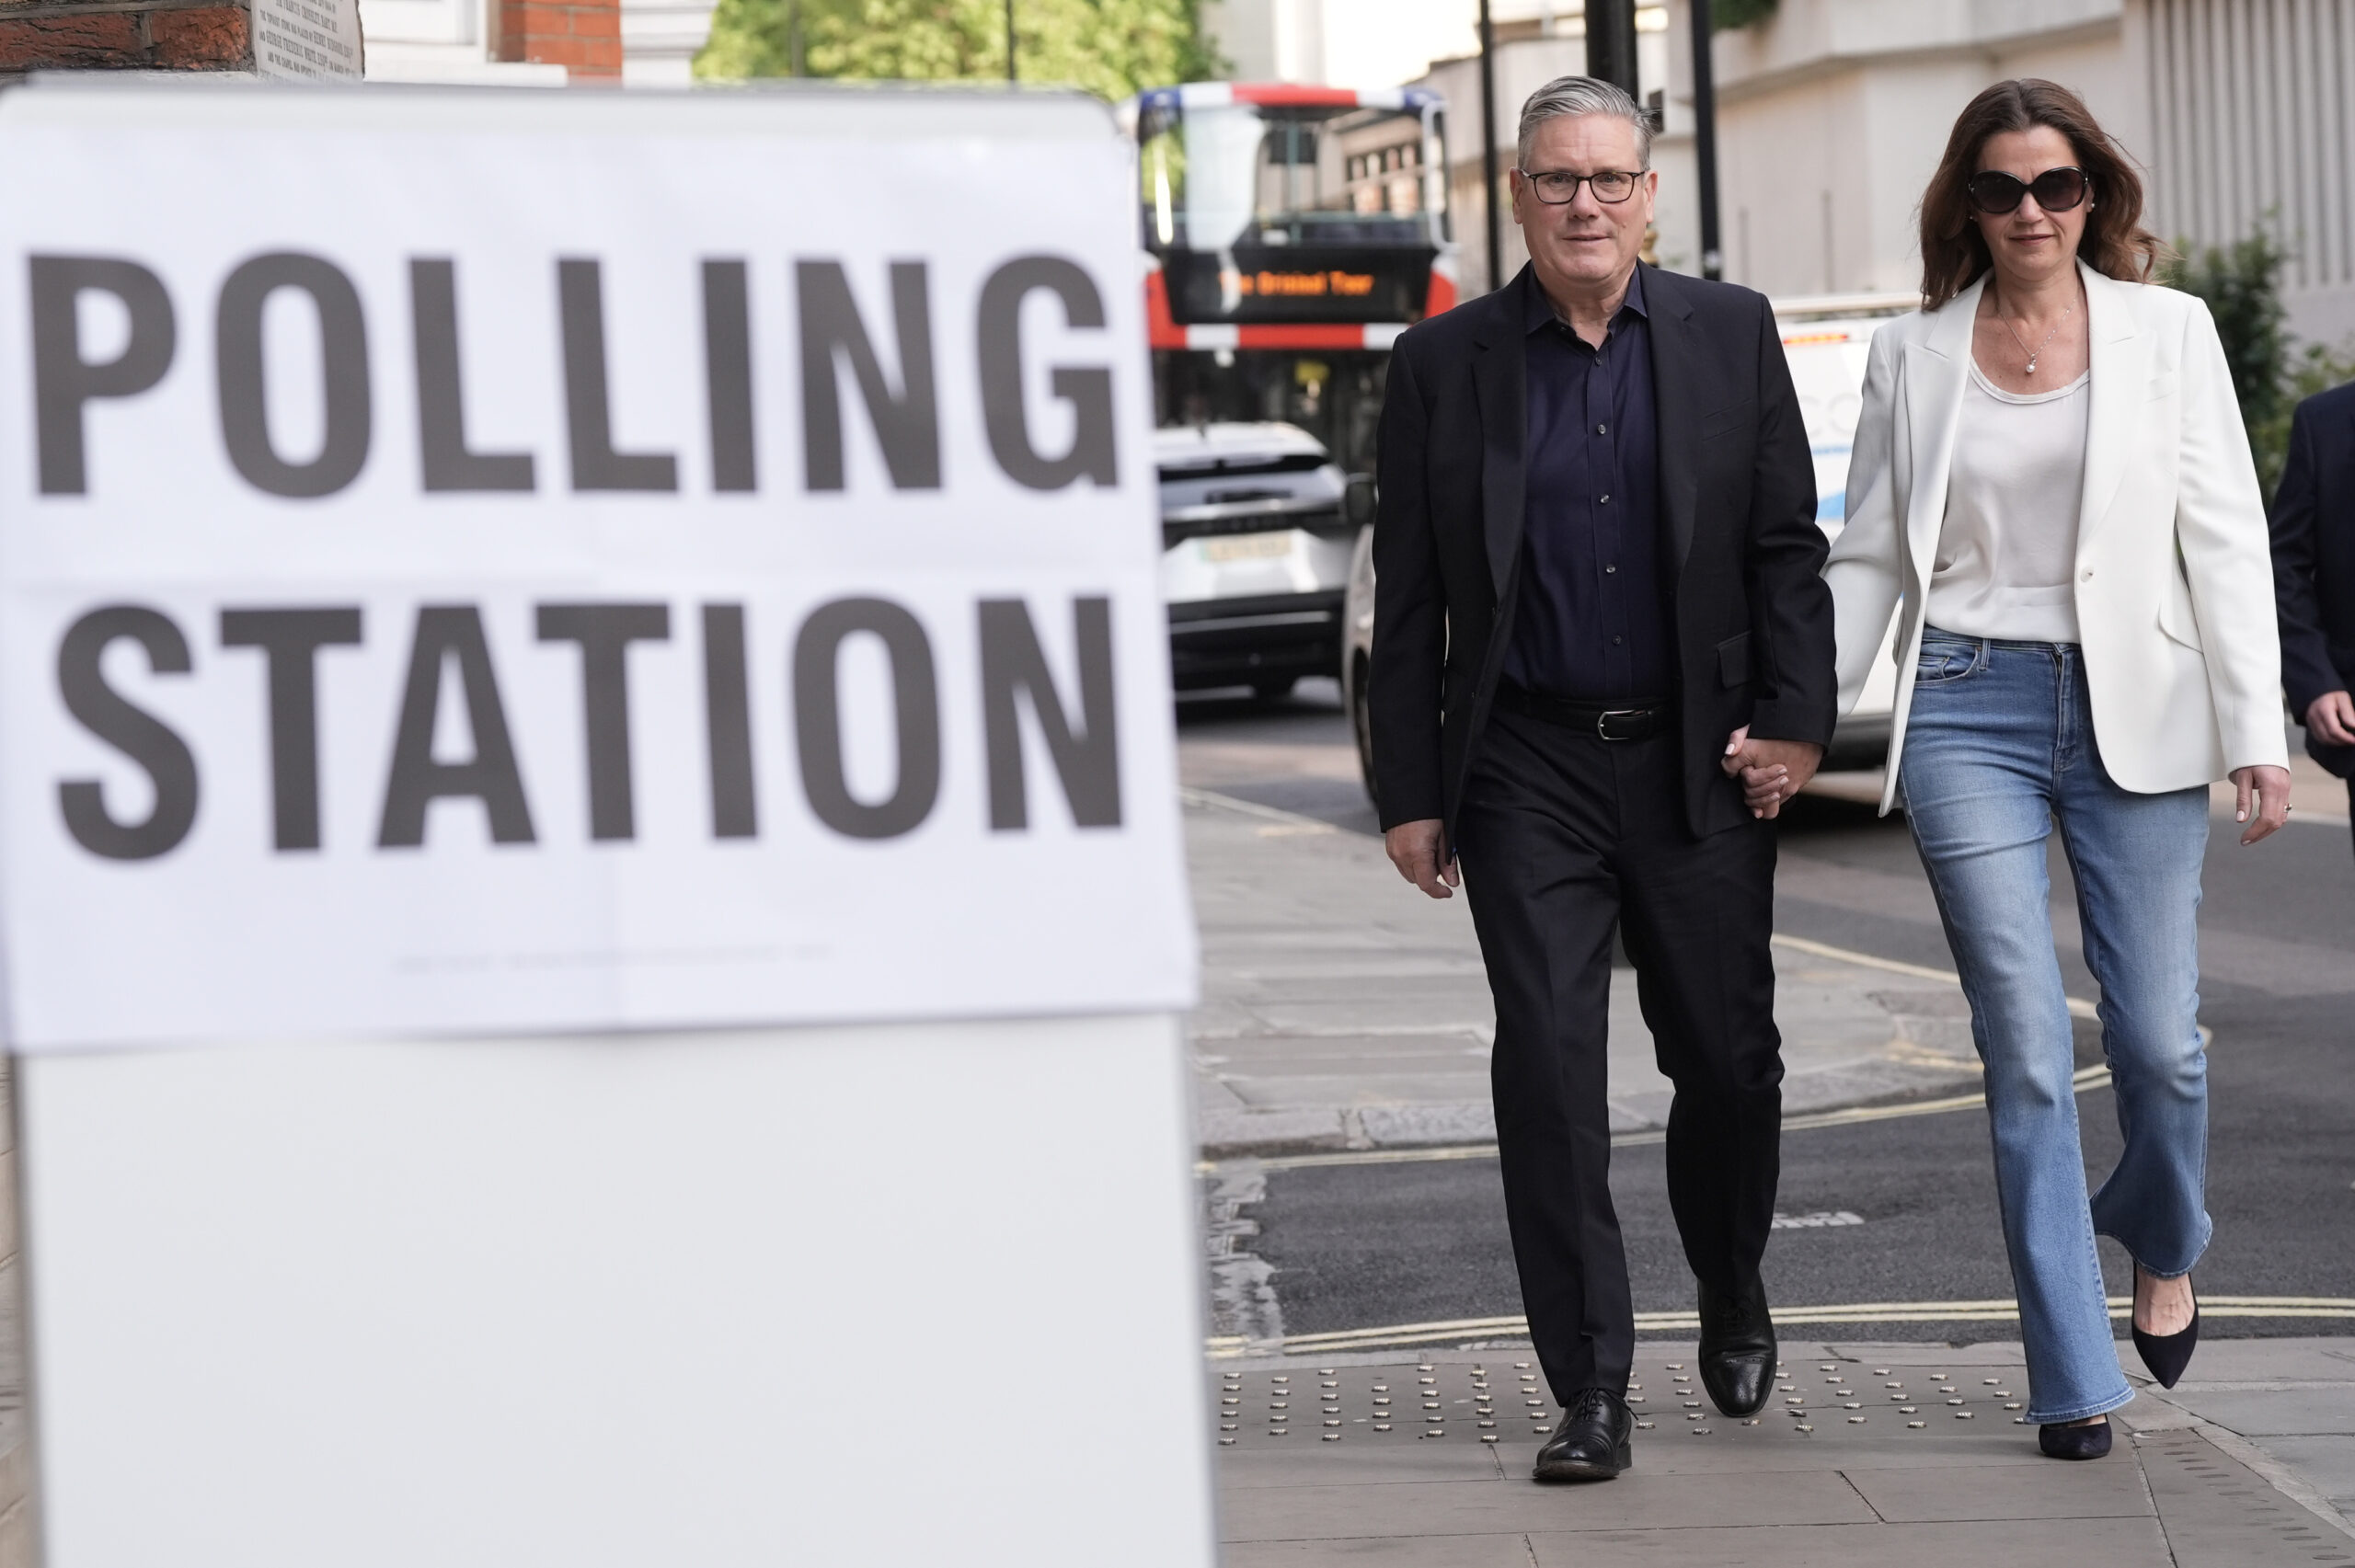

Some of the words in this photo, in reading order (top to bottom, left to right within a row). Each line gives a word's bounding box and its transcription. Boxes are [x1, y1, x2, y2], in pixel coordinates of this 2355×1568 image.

[266, 29, 282, 50] GEORGE
[28, 248, 1120, 499] POLLING
[55, 595, 1123, 864] STATION
